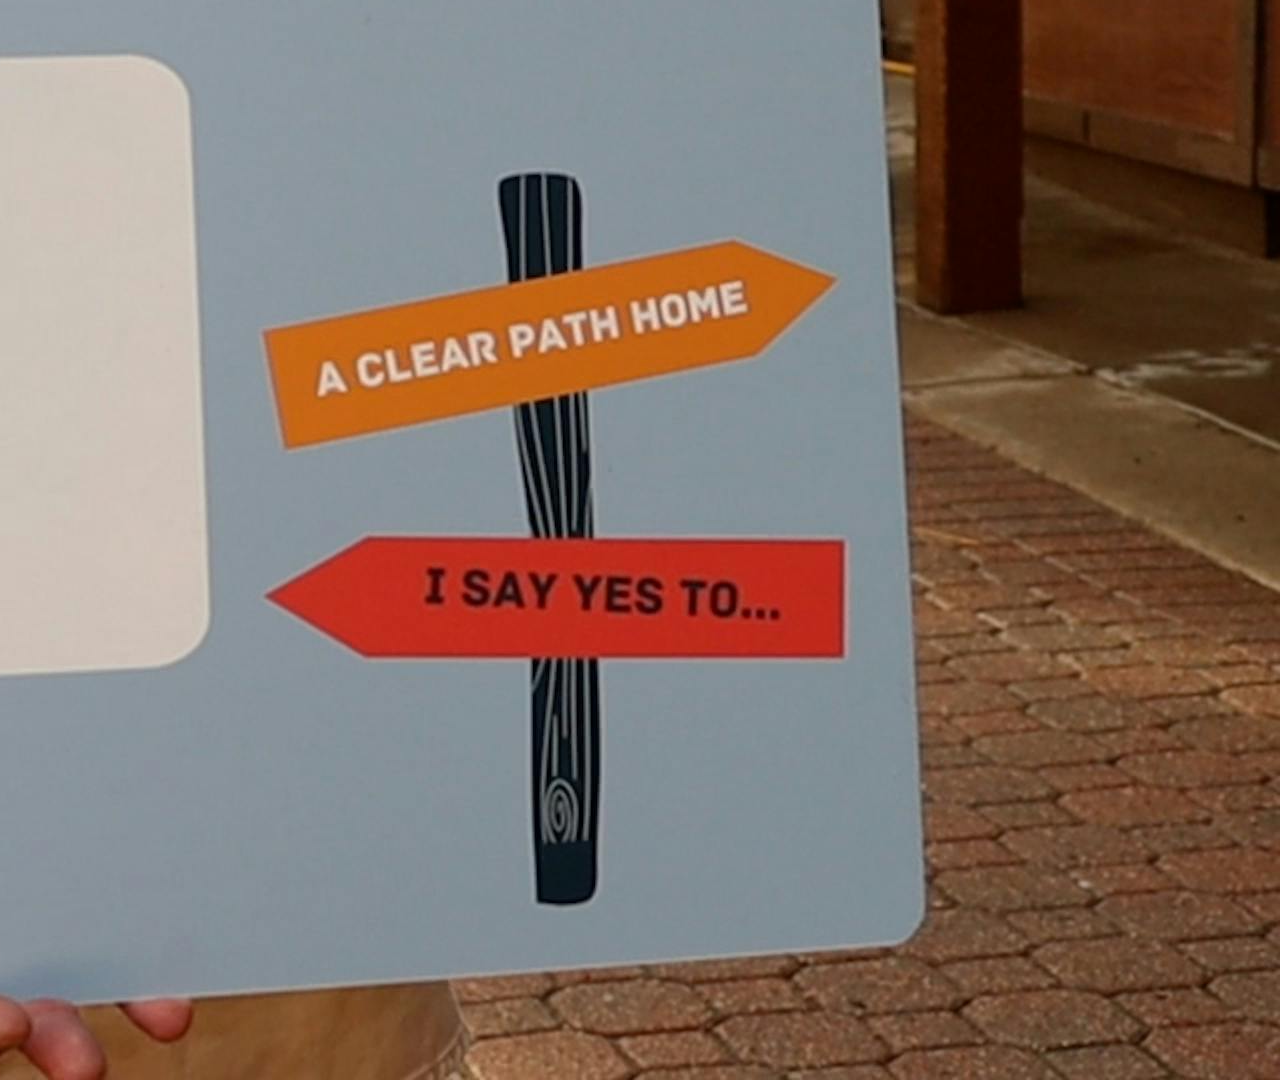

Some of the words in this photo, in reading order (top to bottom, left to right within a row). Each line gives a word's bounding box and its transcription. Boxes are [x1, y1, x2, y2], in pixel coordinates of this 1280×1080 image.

[317, 361, 348, 397] A
[356, 331, 498, 388] CLEAR
[508, 306, 620, 358] PATH
[630, 280, 748, 334] HOME
[424, 566, 447, 606] I
[461, 567, 558, 610] SAY
[572, 573, 665, 617] YES
[678, 578, 781, 621] TO...
